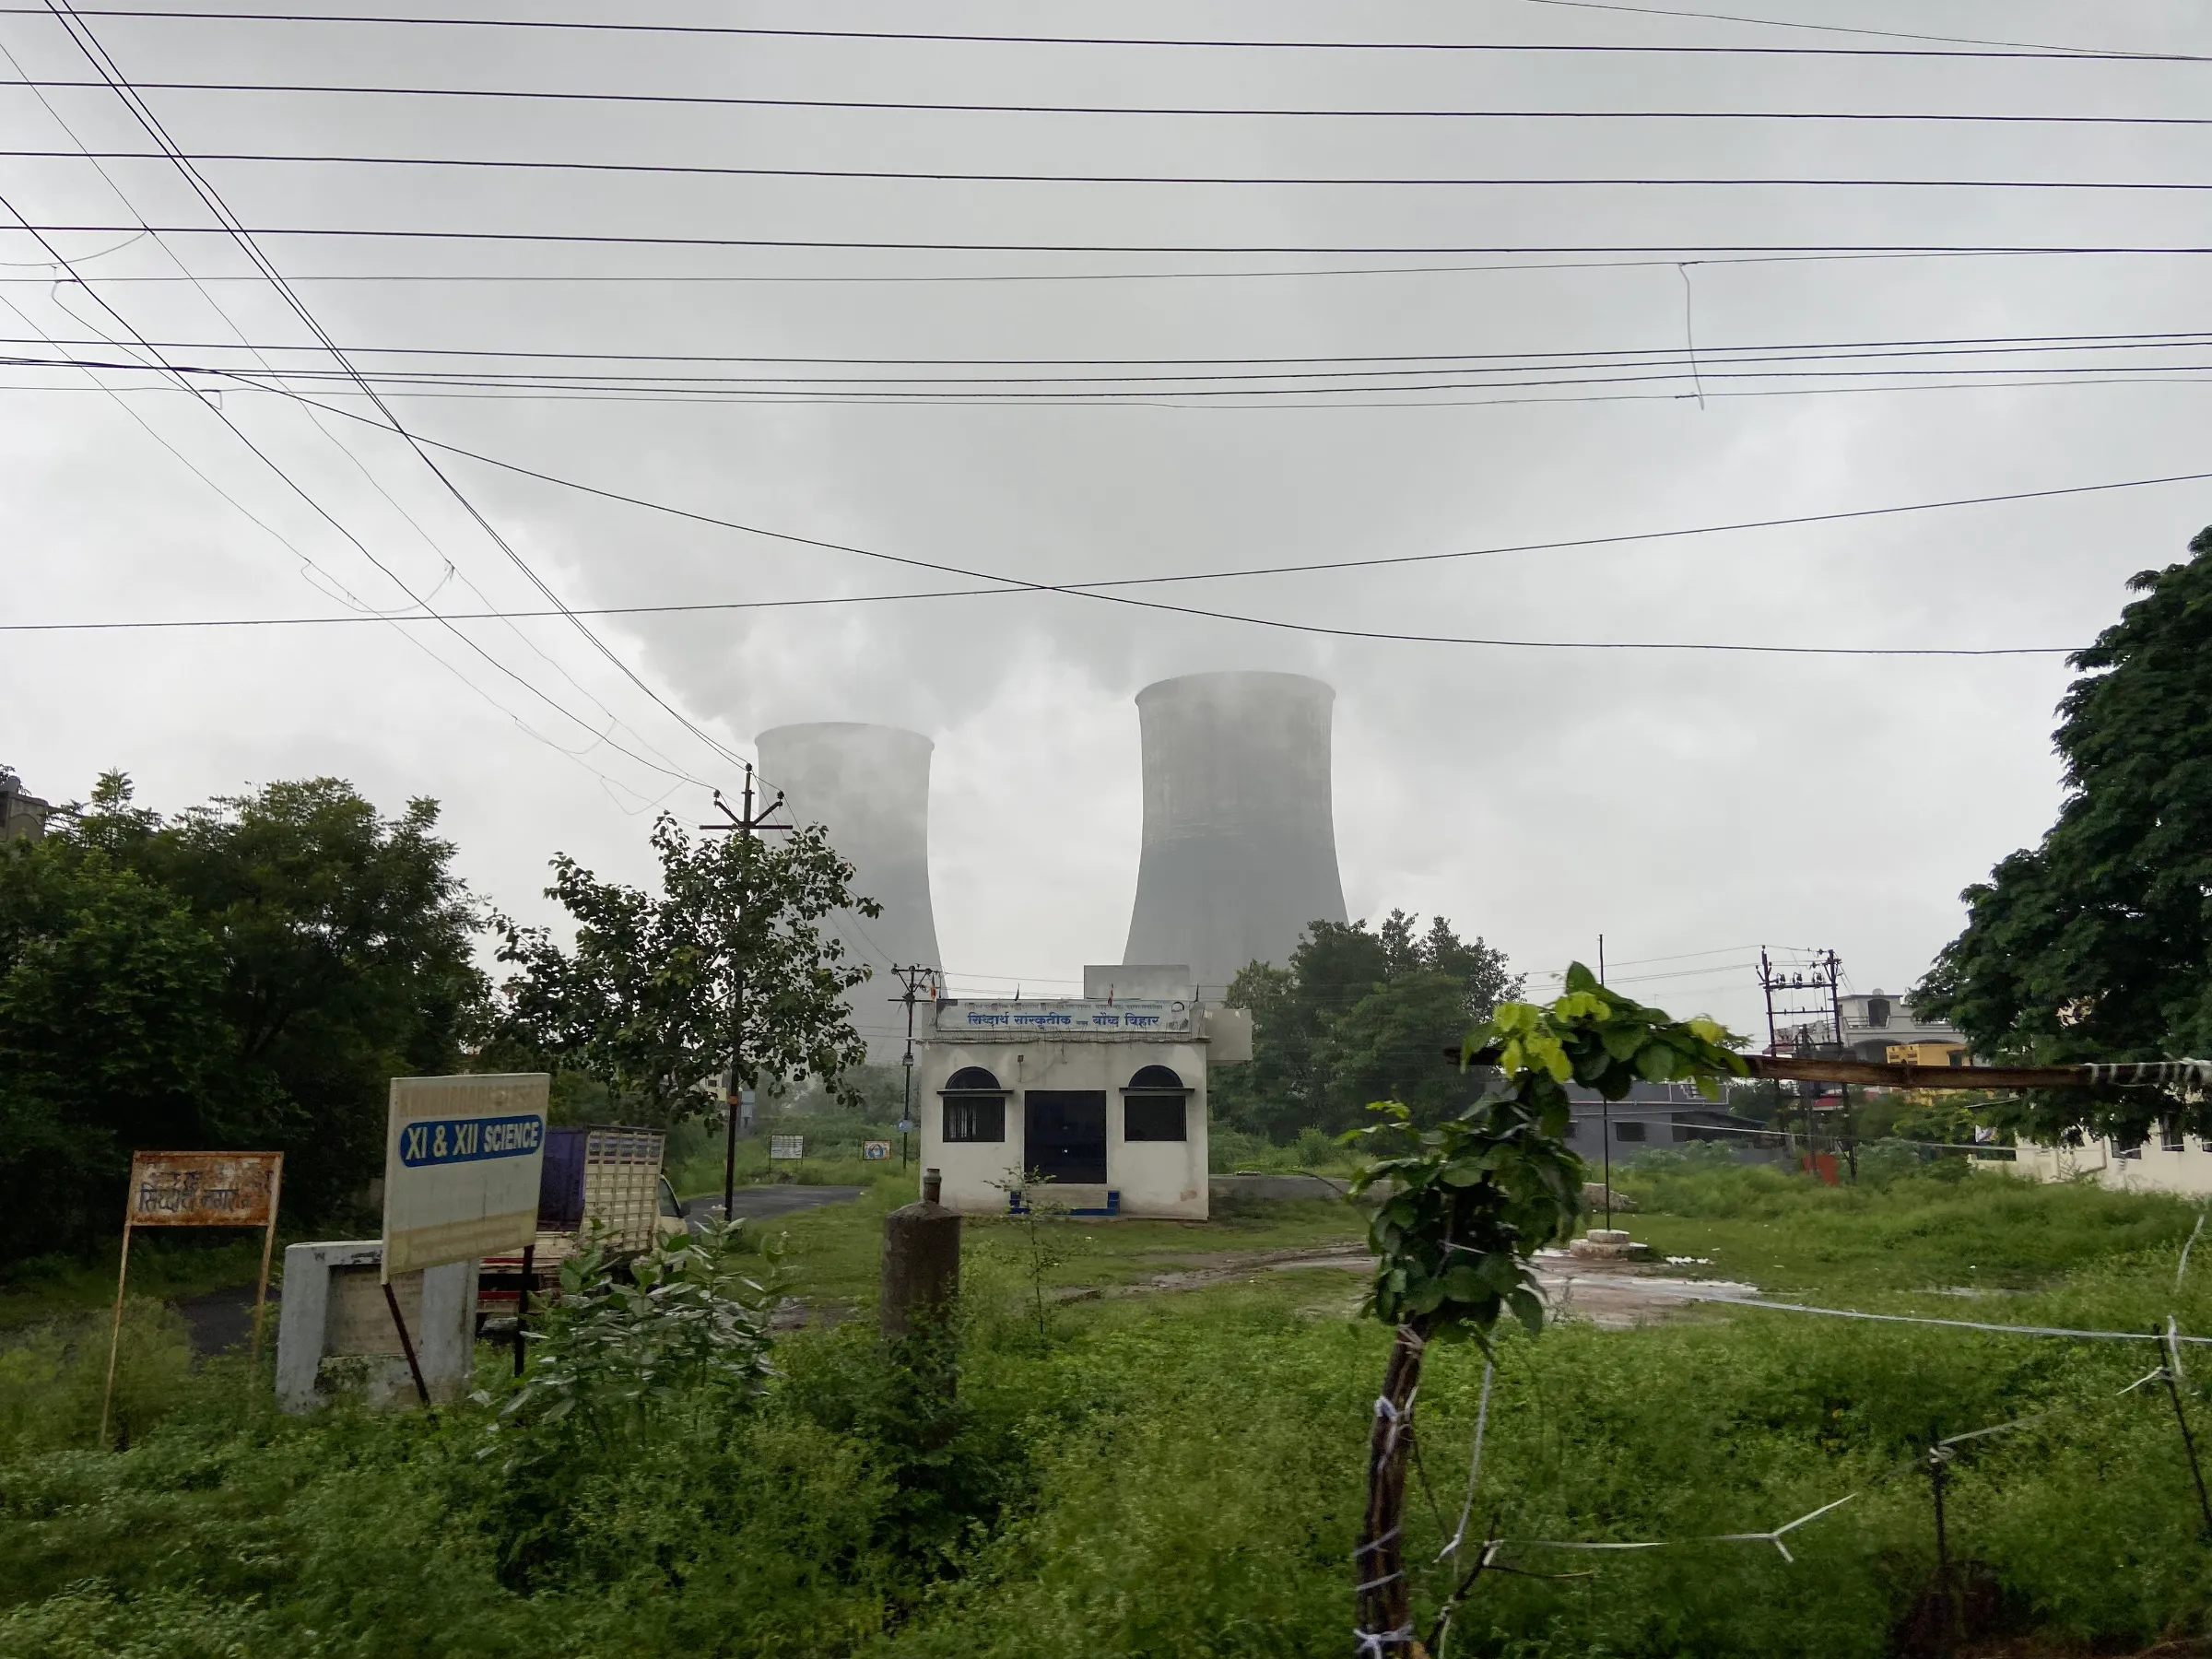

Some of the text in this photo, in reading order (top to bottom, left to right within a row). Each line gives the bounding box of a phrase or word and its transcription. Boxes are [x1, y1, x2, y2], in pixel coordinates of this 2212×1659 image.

[1124, 1012, 1160, 1029] विहार
[406, 1122, 539, 1160] XI & XII SCIENCE
